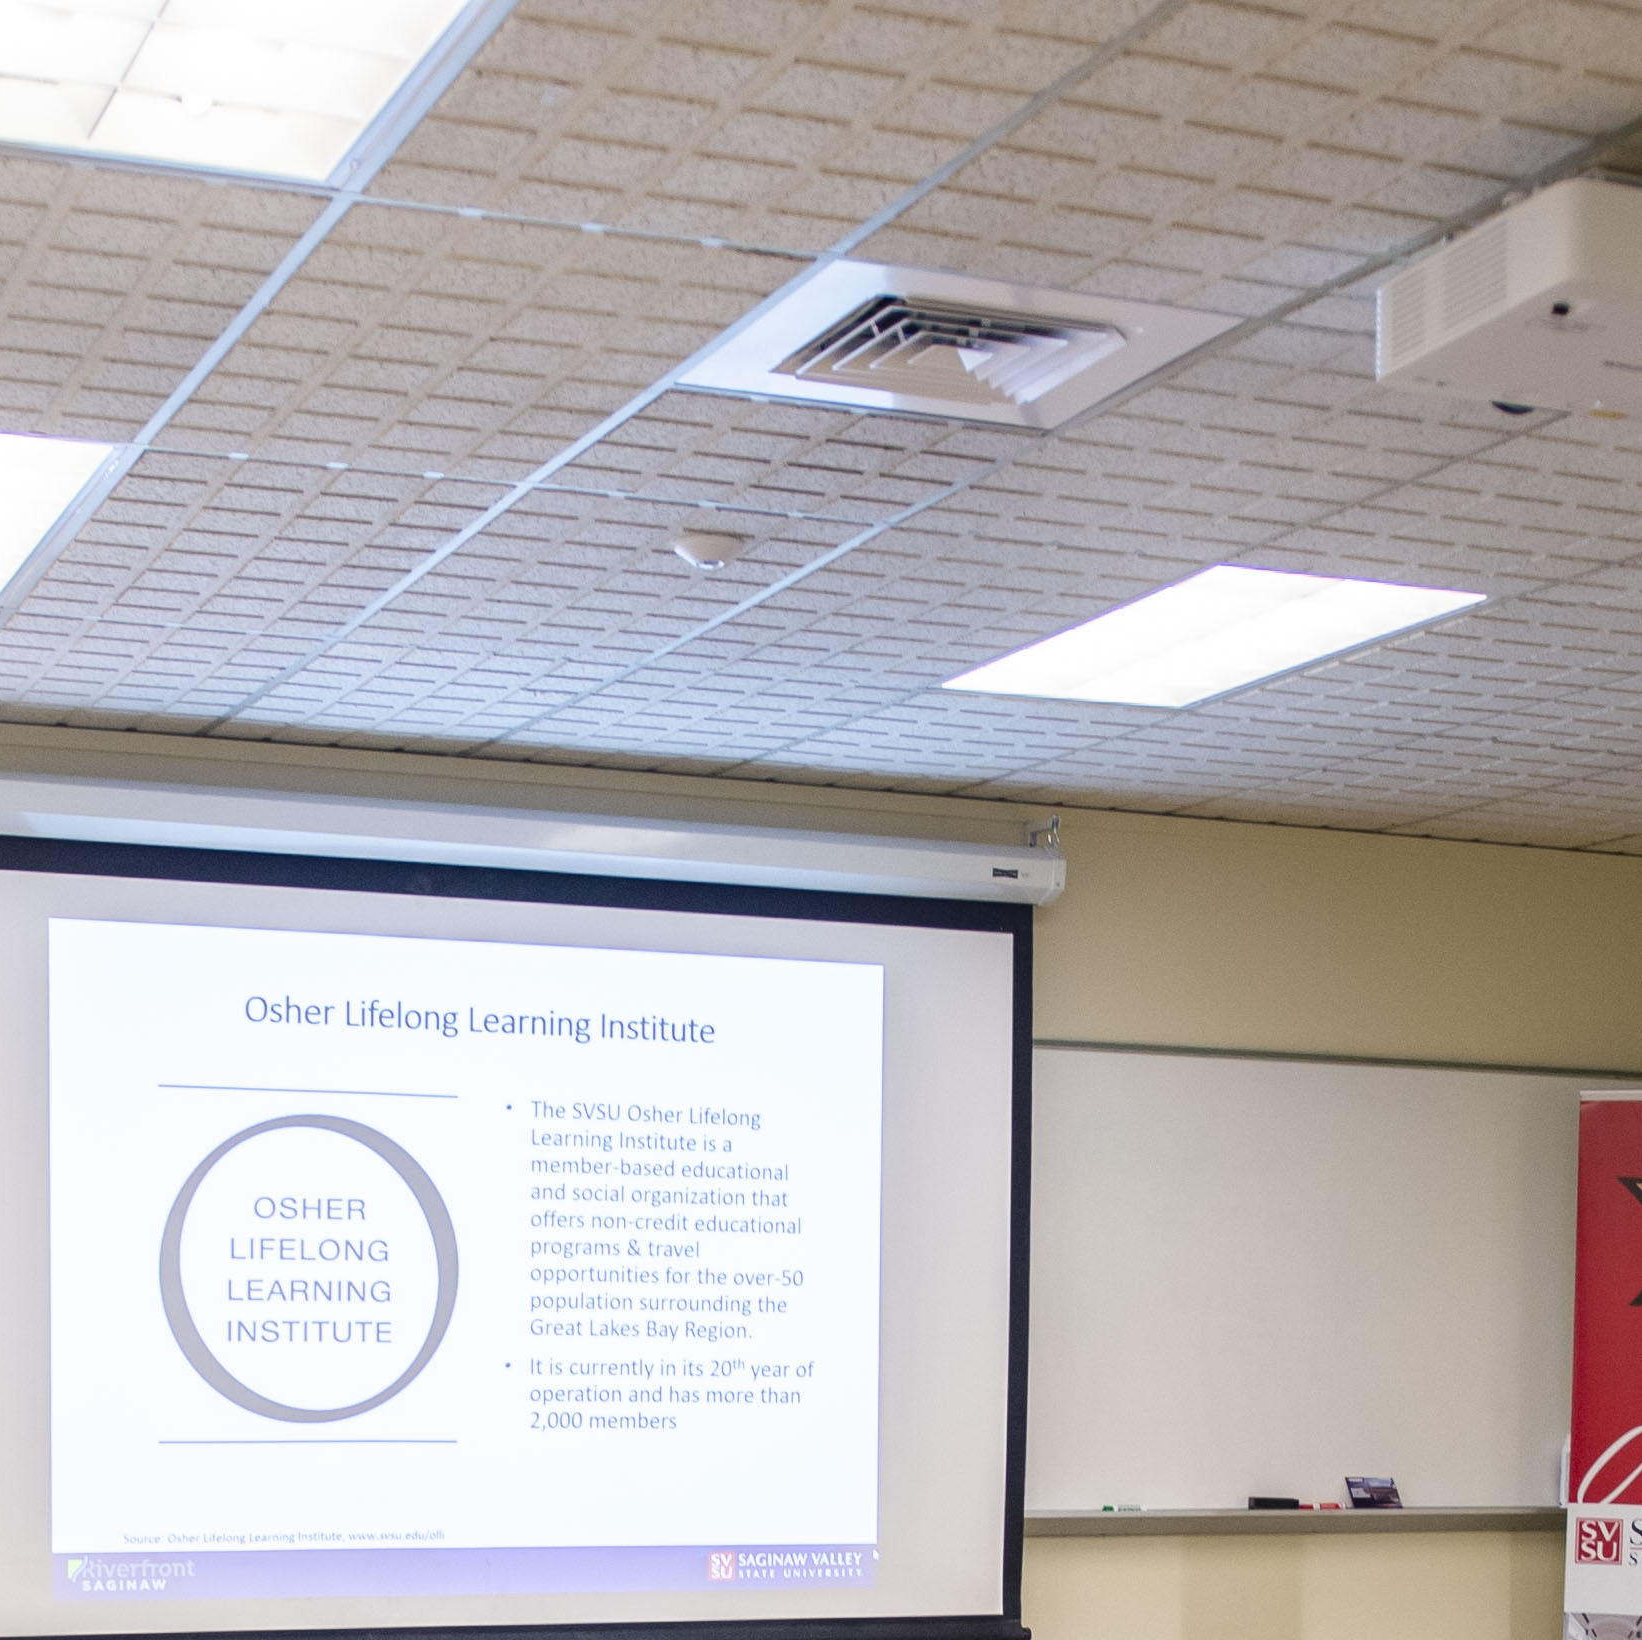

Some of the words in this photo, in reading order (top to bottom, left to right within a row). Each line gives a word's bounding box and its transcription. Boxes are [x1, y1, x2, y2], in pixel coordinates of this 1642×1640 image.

[244, 994, 334, 1028] Osher
[345, 999, 458, 1038] Lifelong
[468, 1006, 591, 1044] Learning
[600, 1011, 716, 1046] Institute
[531, 1100, 565, 1119] The
[572, 1102, 621, 1122] SVSU
[628, 1104, 683, 1124] Osher
[690, 1104, 761, 1130] Lifelong
[532, 1129, 613, 1152] Learning
[620, 1132, 697, 1151] Institute
[704, 1134, 716, 1152] is
[723, 1138, 732, 1153] a
[531, 1157, 674, 1177] member-based
[682, 1161, 788, 1182] educational
[531, 1183, 565, 1201] and
[573, 1185, 625, 1203] social
[631, 1187, 745, 1207] organization
[752, 1190, 788, 1208] that
[254, 1196, 366, 1220] OSHER
[530, 1210, 584, 1228] offers
[592, 1214, 688, 1232] non-credit
[695, 1217, 801, 1235] educational
[230, 1237, 389, 1262] LIFELONG
[530, 1239, 620, 1259] programs
[627, 1239, 641, 1256] &
[648, 1240, 700, 1258] travel
[530, 1266, 659, 1286] opportunities
[666, 1267, 690, 1284] for
[697, 1268, 726, 1286] the
[733, 1270, 804, 1287] over-50
[227, 1279, 391, 1302] LEARNING
[530, 1292, 633, 1312] population
[639, 1295, 751, 1316] surrounding
[758, 1296, 787, 1314] the
[227, 1320, 393, 1343] INSTITUTE
[530, 1319, 582, 1337] Great
[590, 1320, 639, 1338] Lakes
[647, 1321, 679, 1341] Bay
[685, 1321, 752, 1342] Region.
[530, 1358, 542, 1376] It
[550, 1359, 563, 1376] is
[569, 1359, 654, 1380] currently
[660, 1359, 675, 1377] in
[683, 1359, 703, 1377] its
[751, 1363, 790, 1380] year
[796, 1360, 815, 1378] of
[530, 1385, 622, 1405] operation
[629, 1386, 662, 1403] and
[669, 1386, 700, 1404] has
[707, 1390, 754, 1404] more
[761, 1387, 801, 1405] than
[530, 1412, 582, 1432] 2,000
[589, 1412, 677, 1430] members
[168, 1533, 199, 1544] Osher
[203, 1533, 245, 1545] Lifelong
[249, 1532, 295, 1544] Learning
[82, 1559, 196, 1578] Riverfront
[739, 1553, 807, 1567] SAGINAW
[812, 1552, 862, 1566] VALLEY
[82, 1579, 167, 1591] SAGINAW
[739, 1568, 775, 1579] STATE
[784, 1568, 863, 1578] UNIVERSITY
